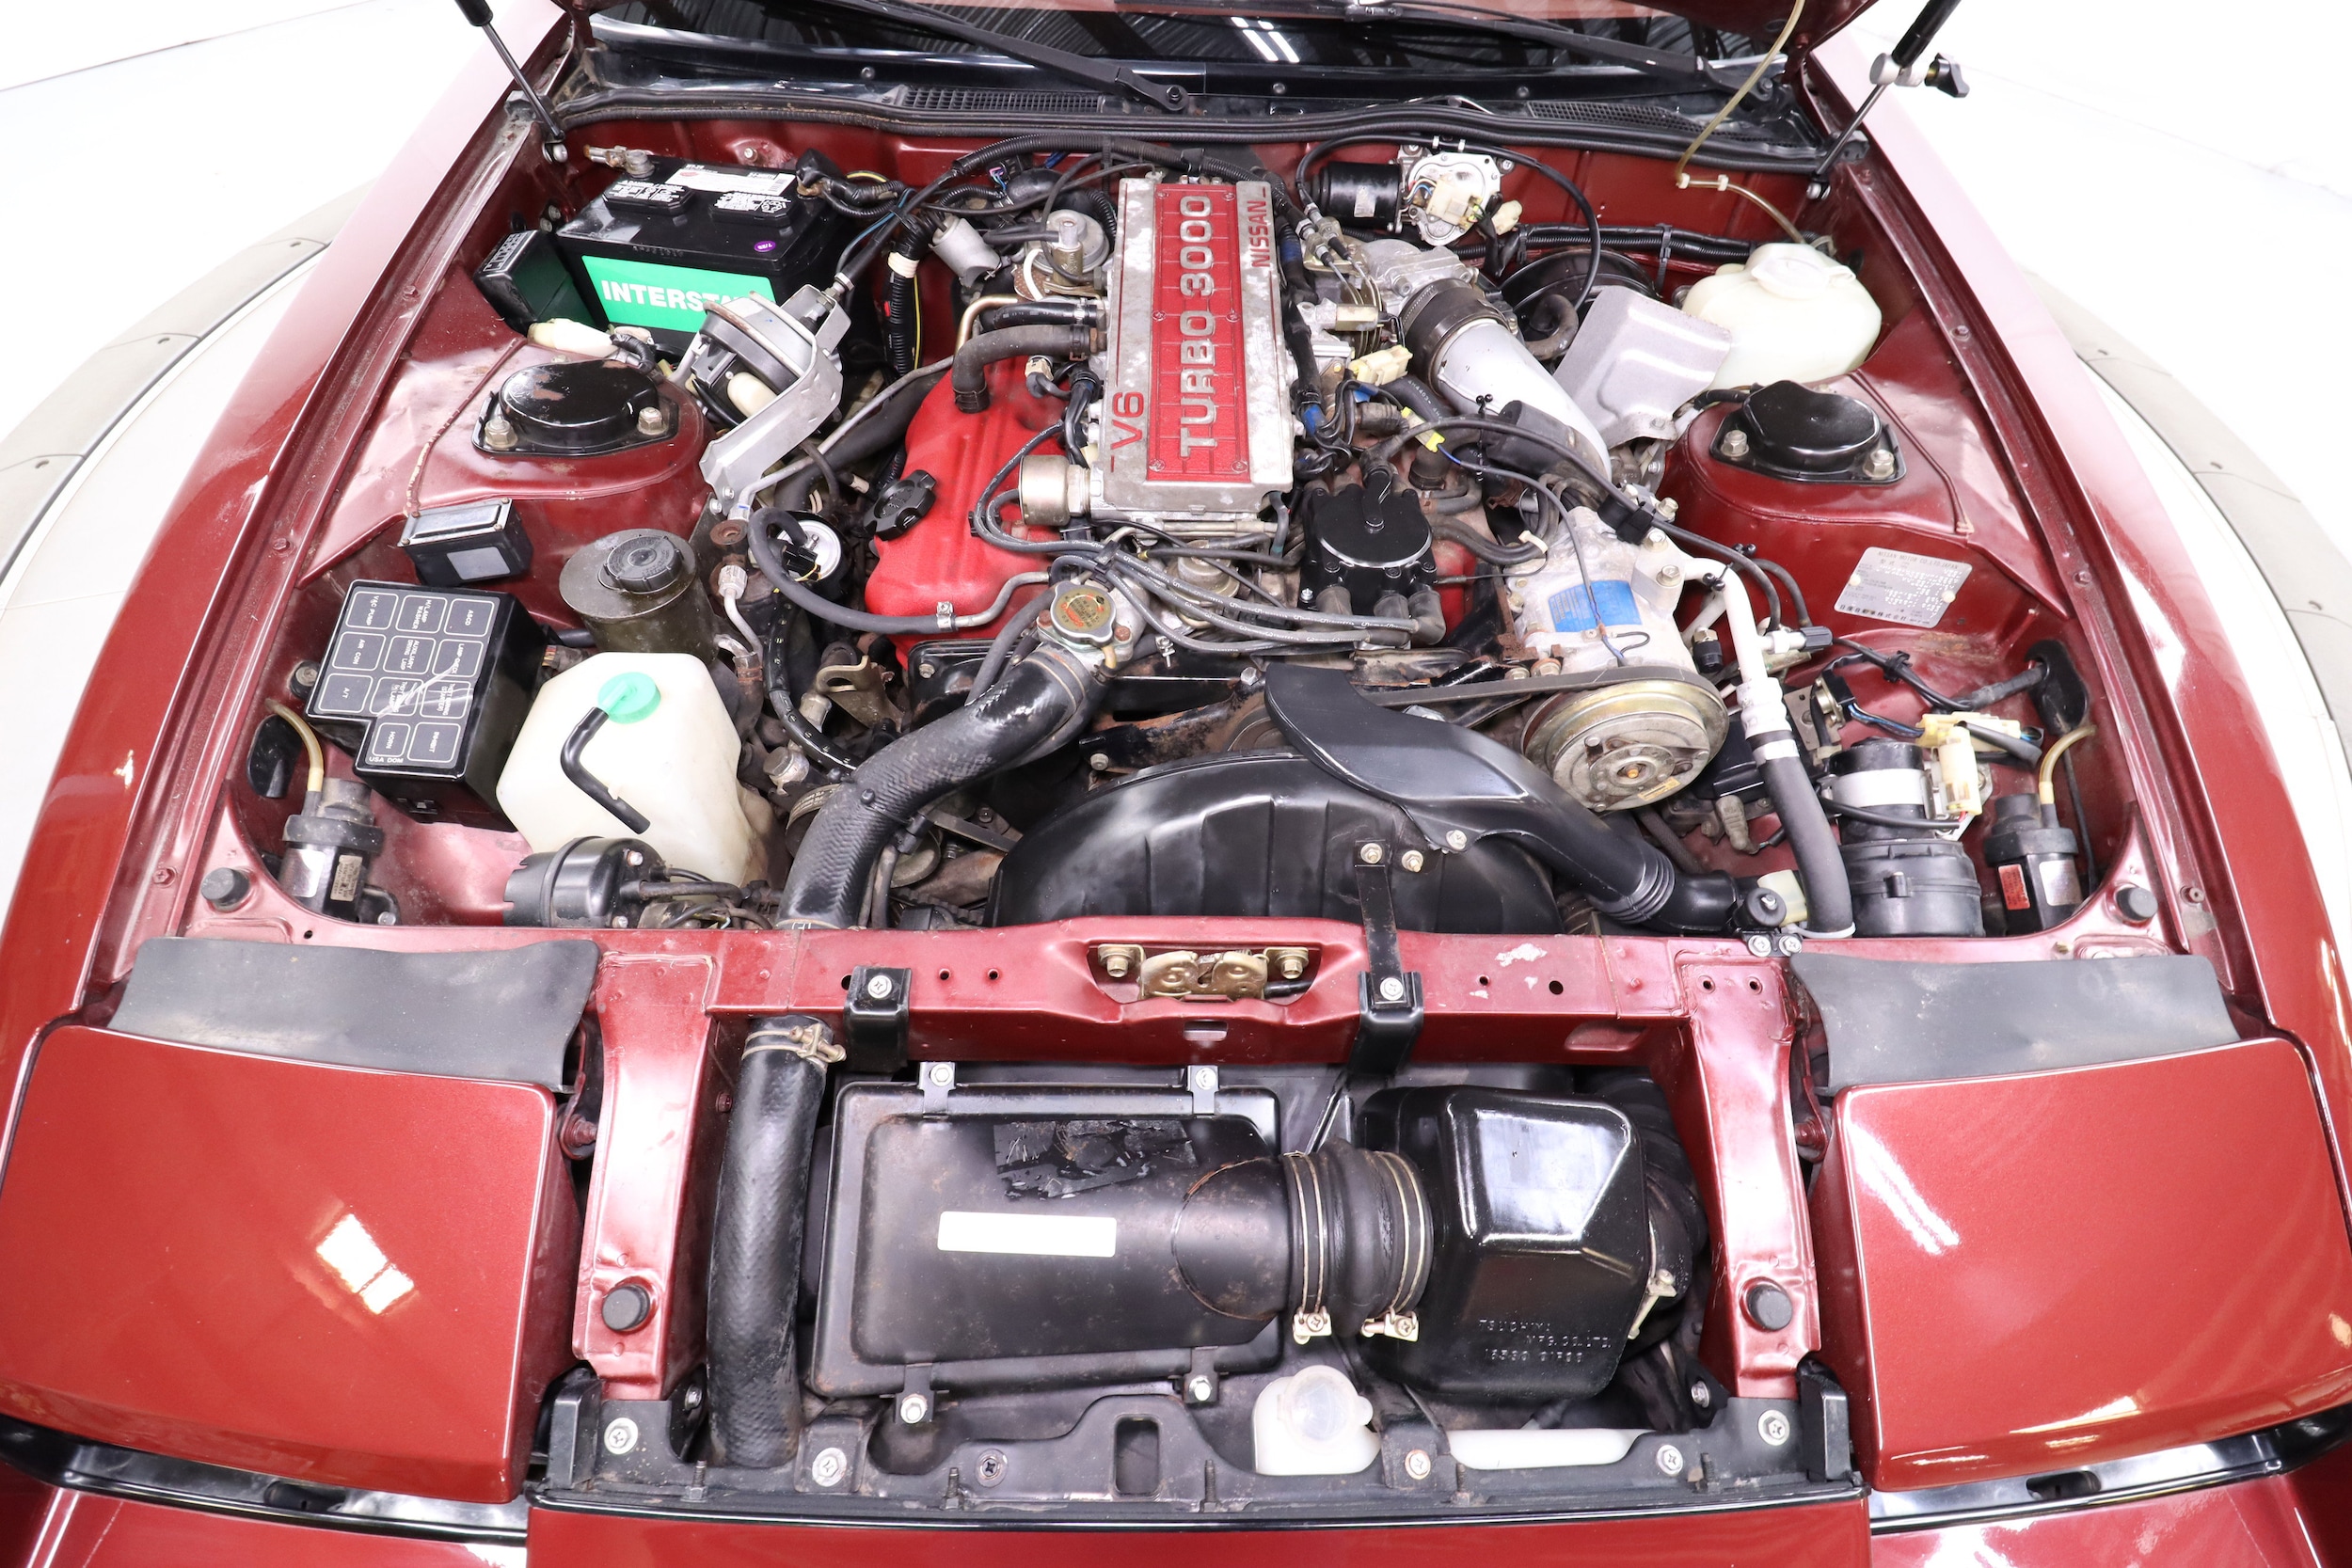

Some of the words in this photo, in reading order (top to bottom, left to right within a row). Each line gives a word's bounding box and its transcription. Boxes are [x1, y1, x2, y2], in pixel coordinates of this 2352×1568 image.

[1251, 199, 1271, 268] NISSAN
[1179, 195, 1216, 297] 3000
[601, 279, 739, 313] INTERST
[1179, 309, 1217, 458] TURBO
[1111, 391, 1145, 450] V6
[366, 609, 375, 626] PUMP
[411, 606, 424, 630] WASHER
[421, 599, 433, 624] H/LAMP
[465, 609, 474, 626] ASCD
[358, 639, 366, 649] AIR
[404, 639, 414, 656] DRIVING
[352, 652, 362, 665] CON
[400, 657, 408, 671] LAMP
[406, 640, 421, 670] AUXILIARY
[342, 688, 351, 699] A/T
[447, 683, 456, 696] THEFT
[386, 731, 396, 750] HORN
[429, 731, 440, 753] INHIBIT
